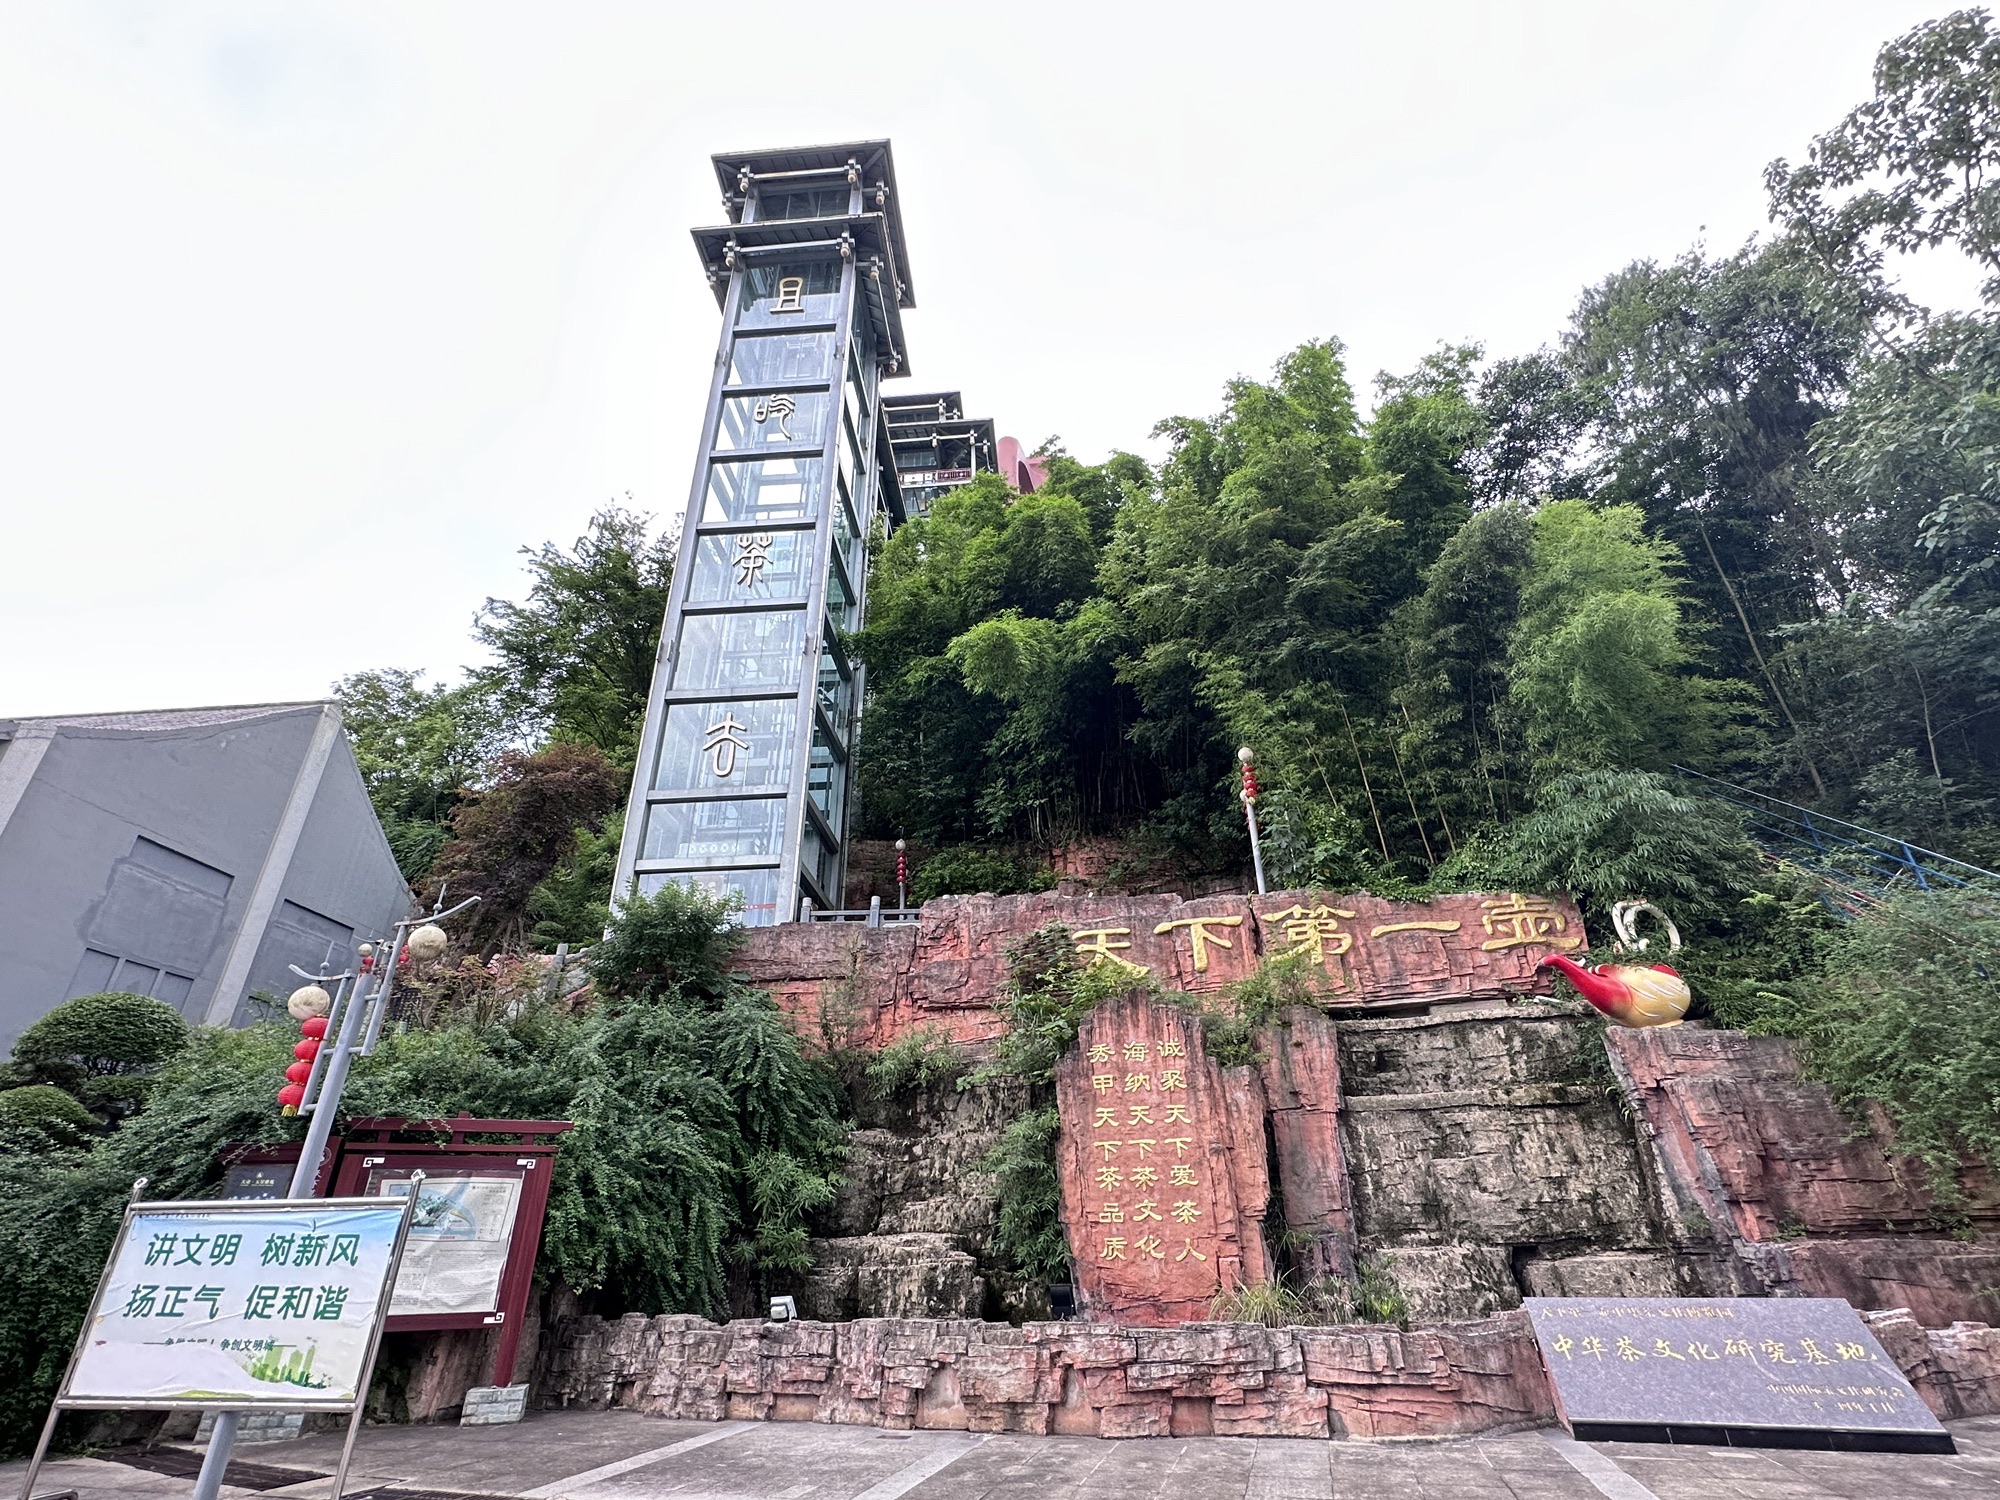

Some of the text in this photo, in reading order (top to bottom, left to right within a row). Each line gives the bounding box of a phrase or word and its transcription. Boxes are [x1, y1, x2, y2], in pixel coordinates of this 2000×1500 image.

[1086, 1043, 1128, 1261] 秀甲天下茶品质
[1122, 1041, 1166, 1260] 海纳天下茶文化
[1157, 1040, 1207, 1263] 诚聚天下爱茶人
[122, 1283, 349, 1321] 扬正气 促和谐
[144, 1232, 361, 1267] 讲文明 树新风
[1550, 1333, 1878, 1367] 中华茶文化研究基地
